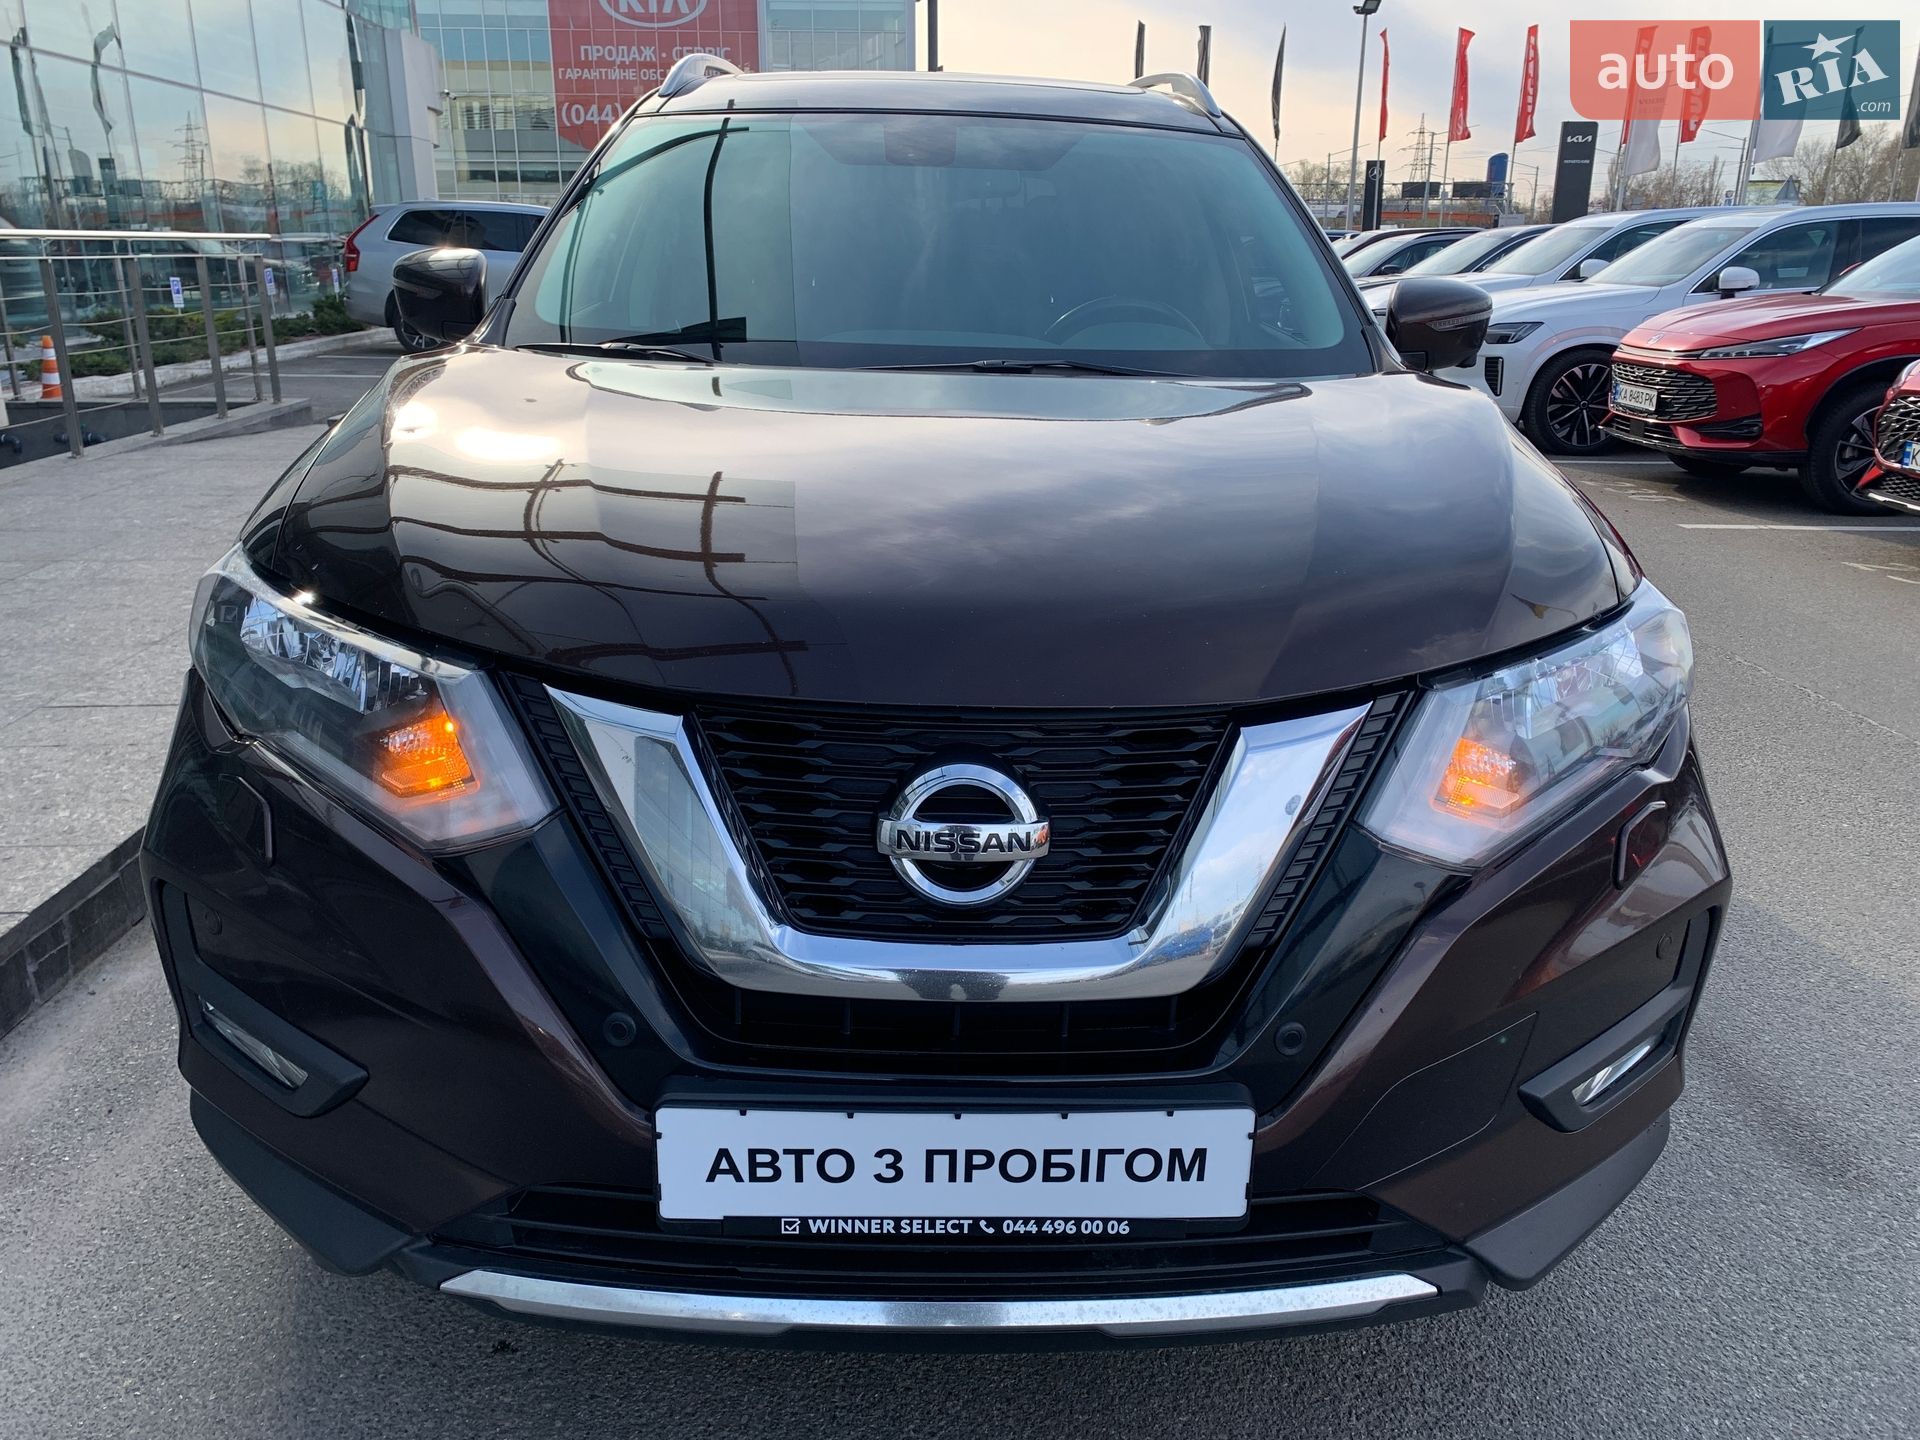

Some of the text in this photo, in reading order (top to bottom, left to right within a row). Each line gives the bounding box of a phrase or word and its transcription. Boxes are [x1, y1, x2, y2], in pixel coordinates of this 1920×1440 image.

[579, 45, 656, 65] ПРОДАЖ
[558, 67, 637, 80] ГАРАНТІЙНЕ
[561, 102, 624, 127] (044)
[895, 829, 1031, 854] NISSAN
[705, 1147, 856, 1184] АВТО
[924, 1147, 1208, 1184] ПРОБІГОМ
[808, 1218, 1131, 1235] WINNER SELECT 044 496 00 06
